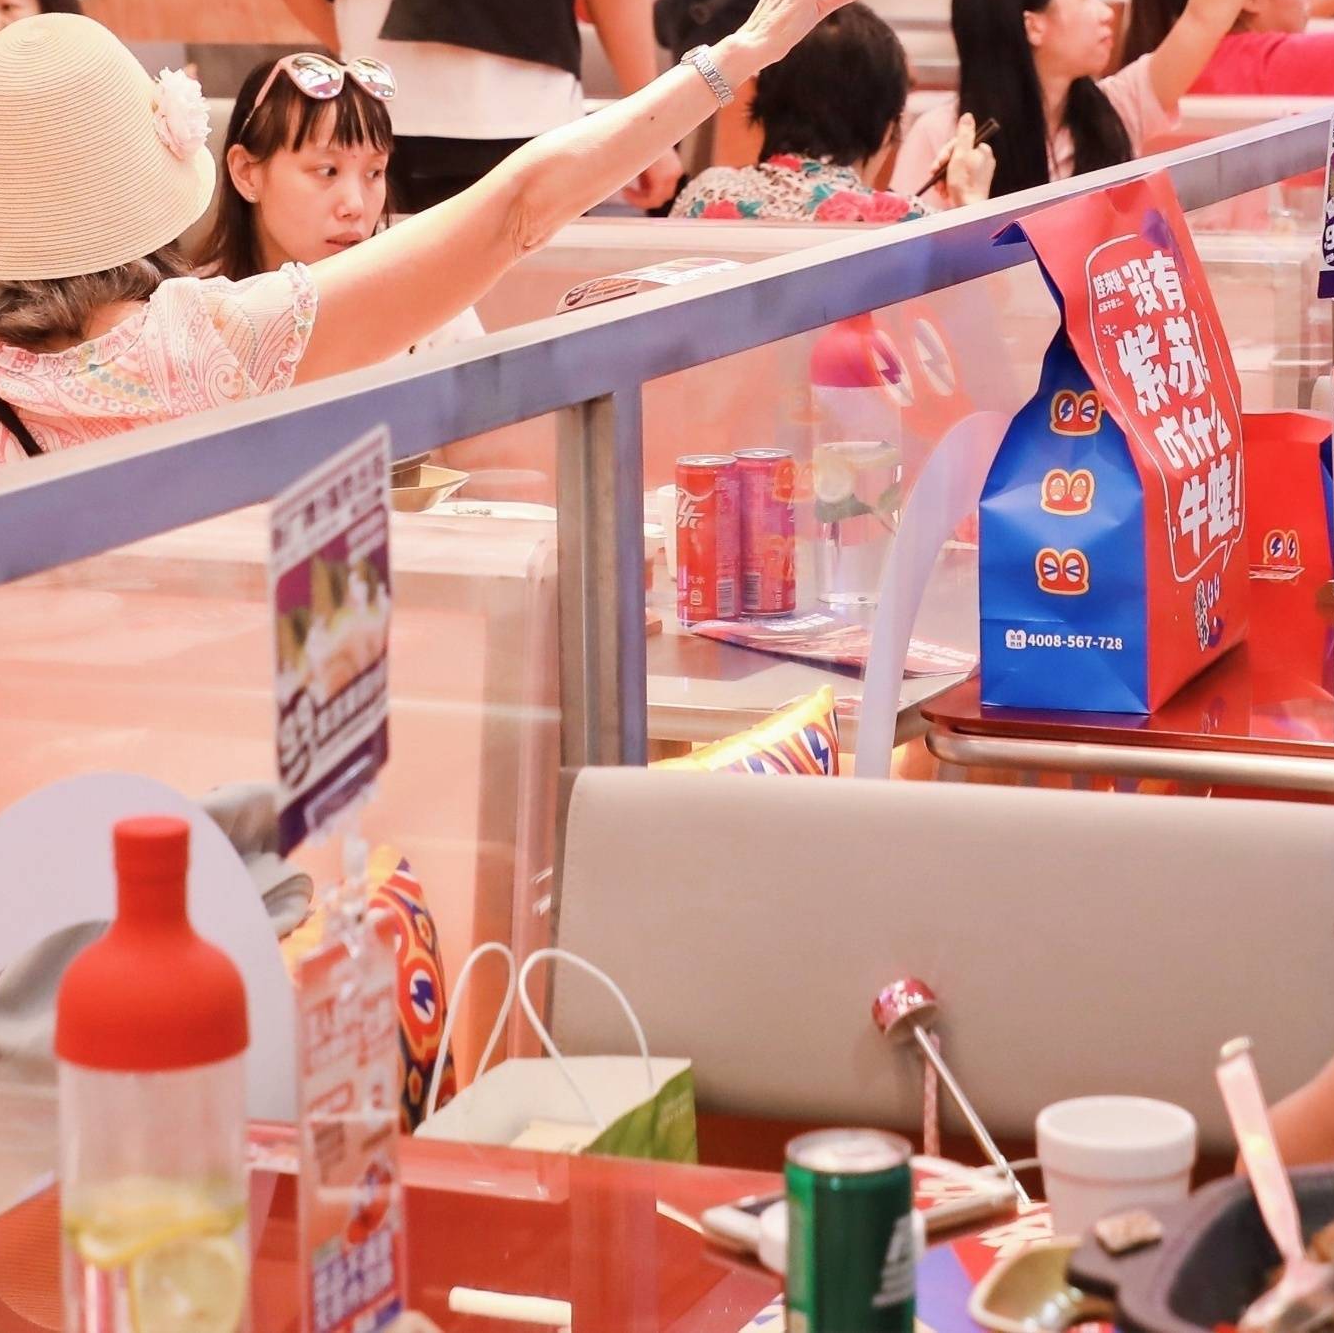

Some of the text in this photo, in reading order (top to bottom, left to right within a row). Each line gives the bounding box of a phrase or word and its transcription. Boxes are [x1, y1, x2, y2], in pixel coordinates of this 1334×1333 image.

[1120, 250, 1187, 317] 没有
[1115, 310, 1211, 417] 紫苏!
[1154, 393, 1232, 469] 吃什么
[1178, 451, 1241, 558] 牛蛙!
[1027, 633, 1123, 650] 4008-567-728
